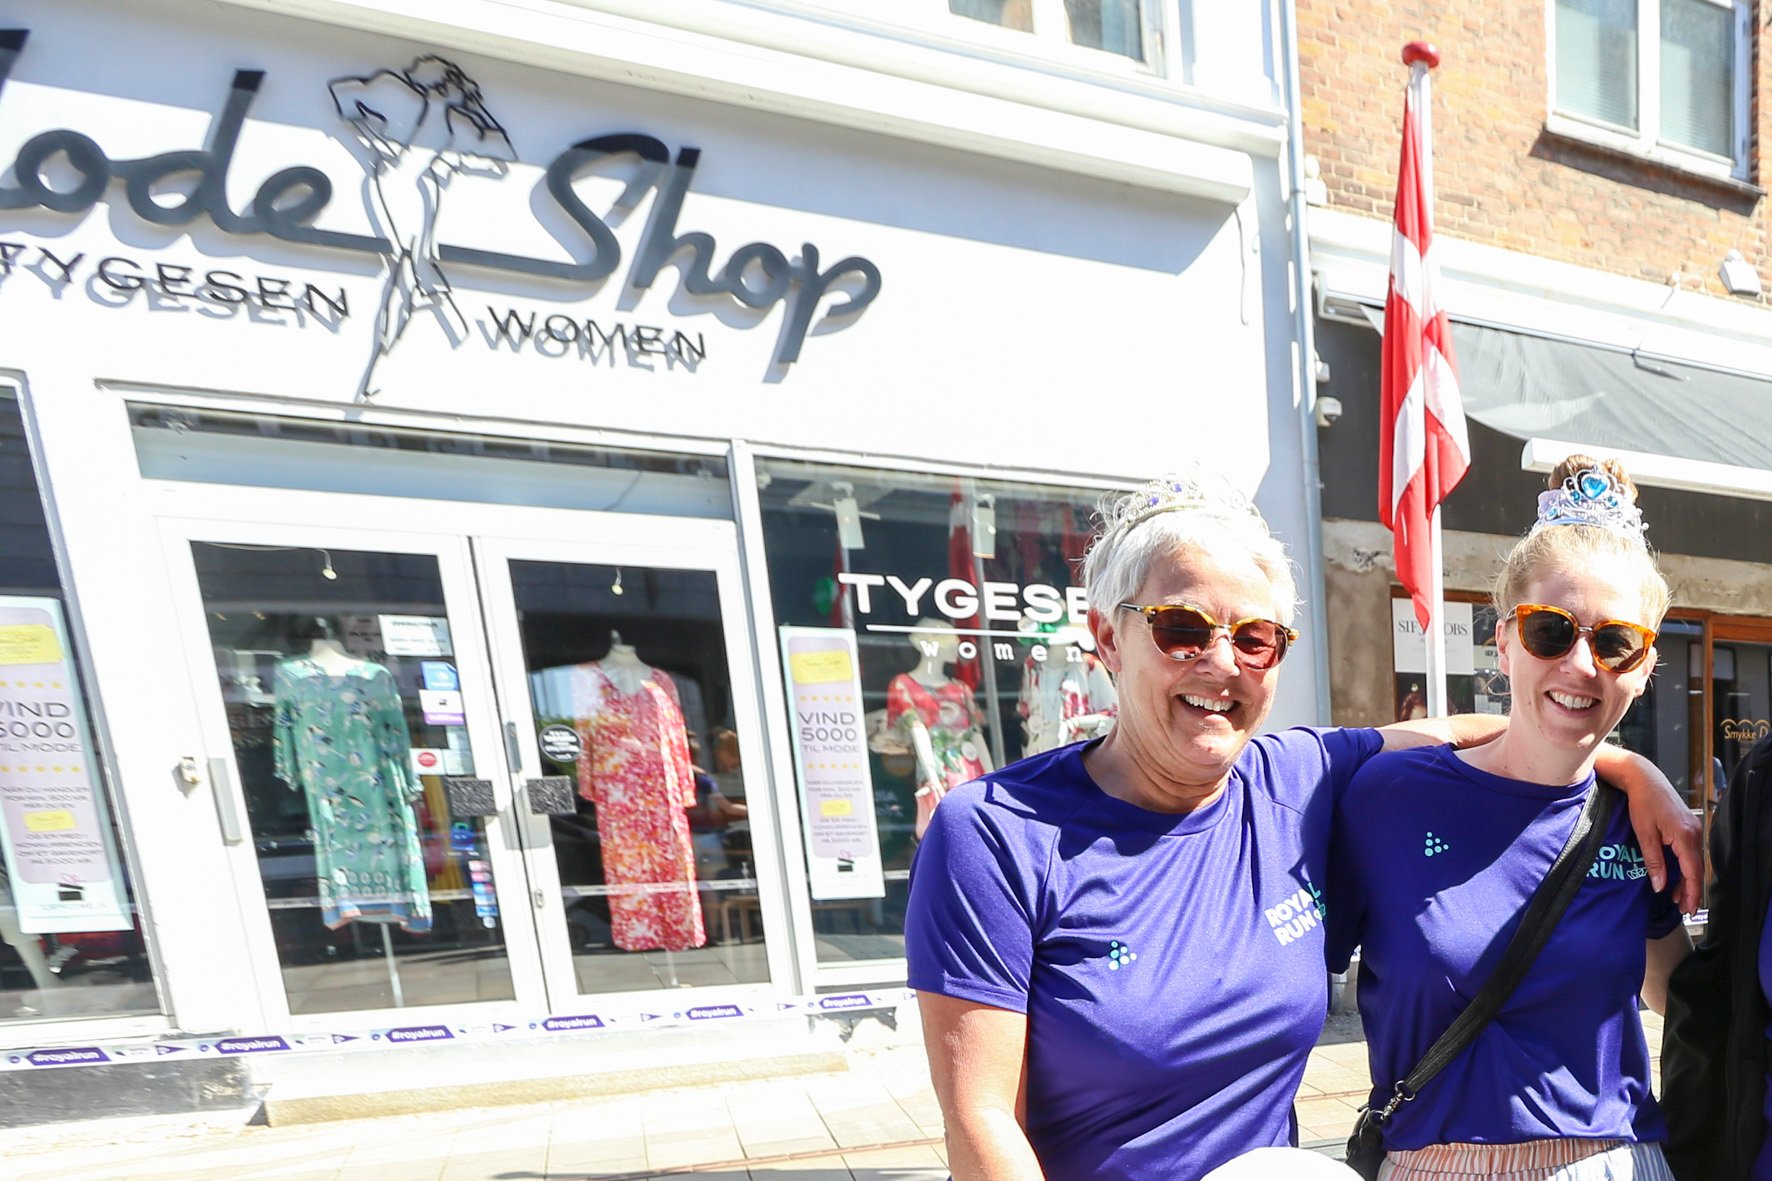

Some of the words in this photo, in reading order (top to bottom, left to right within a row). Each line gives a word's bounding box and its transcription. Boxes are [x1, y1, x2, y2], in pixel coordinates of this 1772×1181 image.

[546, 132, 882, 364] Shop
[487, 305, 707, 360] WOMEN
[920, 640, 1084, 663] women
[799, 712, 855, 725] VIND
[801, 727, 857, 742] 5000
[1725, 724, 1757, 742] Smykke
[1596, 844, 1644, 863] OYAL
[1586, 861, 1625, 880] RUN
[1264, 882, 1321, 928] ROYAL
[1273, 910, 1317, 946] RUN
